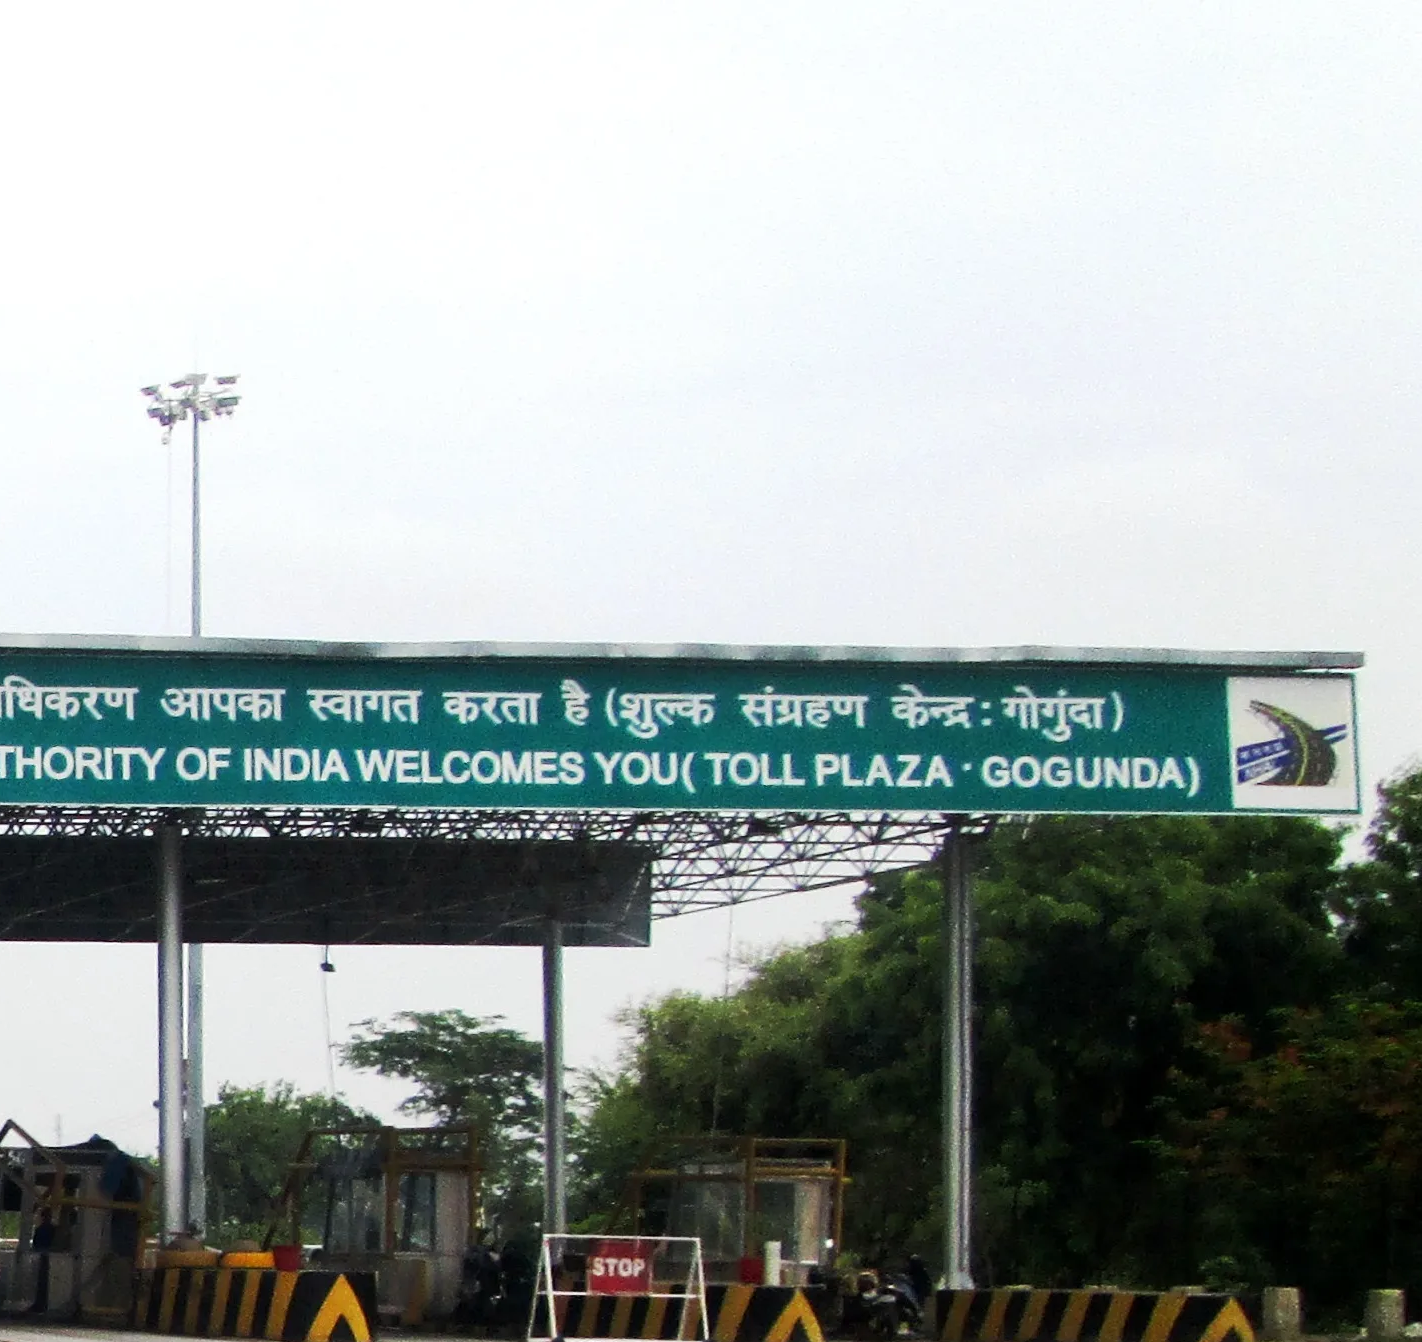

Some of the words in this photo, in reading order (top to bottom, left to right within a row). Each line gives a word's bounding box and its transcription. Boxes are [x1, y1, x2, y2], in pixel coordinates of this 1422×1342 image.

[161, 688, 285, 721] आपका
[307, 690, 422, 723] स्वागत
[443, 692, 541, 724] करता
[561, 680, 590, 725] है
[739, 686, 868, 727] संग्रहण
[176, 747, 231, 780] OF
[244, 748, 349, 781] INDIA
[356, 750, 585, 784] WELCOMES
[705, 753, 805, 785] TOLL
[816, 754, 953, 787] PLAZA
[592, 1258, 645, 1276] STOP
